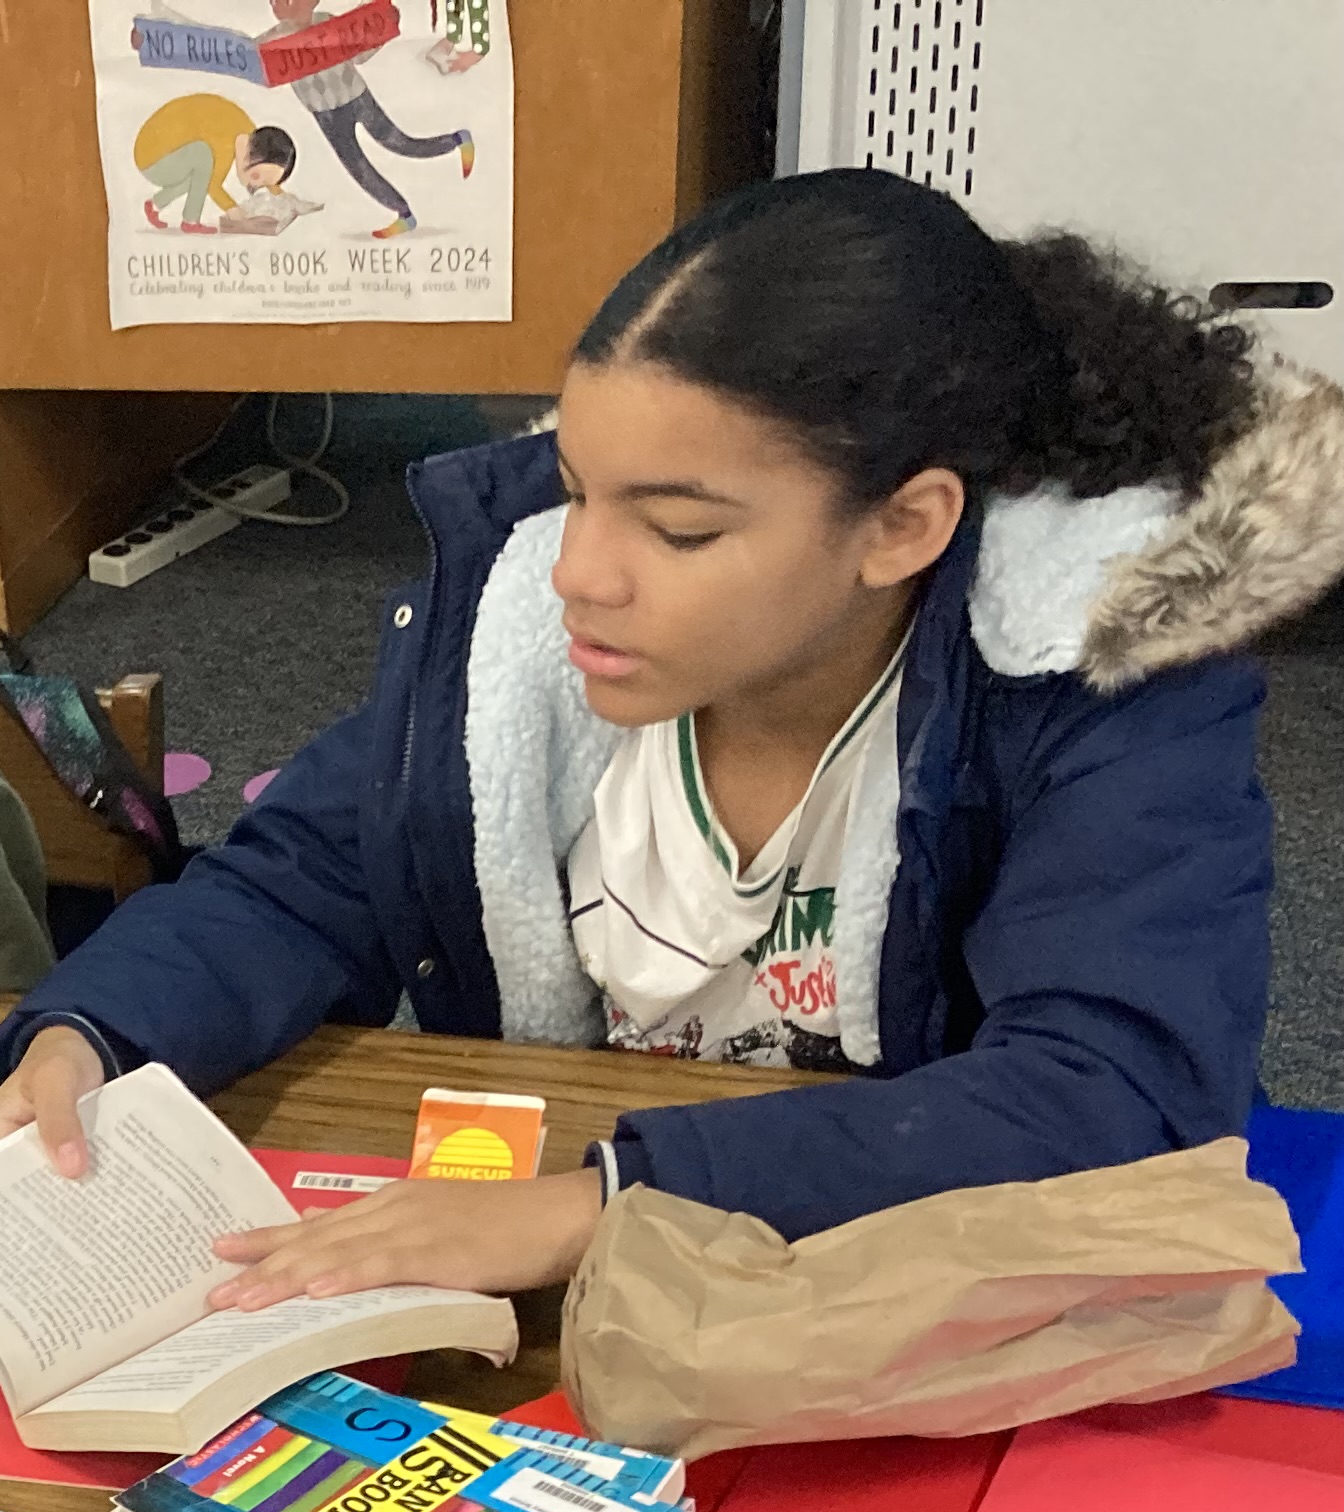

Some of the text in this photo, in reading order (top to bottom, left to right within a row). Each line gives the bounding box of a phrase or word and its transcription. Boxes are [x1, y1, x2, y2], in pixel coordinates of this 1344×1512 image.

[144, 28, 249, 72] NO RULES
[278, 12, 387, 77] JUST READ
[127, 246, 492, 279] CHILDREN'S BOOK WEEK 2024
[327, 277, 351, 292] and
[362, 278, 411, 300] reading
[422, 279, 457, 292] since
[428, 1163, 512, 1180] SUNCUP
[344, 1407, 413, 1442] S
[223, 1453, 257, 1477] Novel
